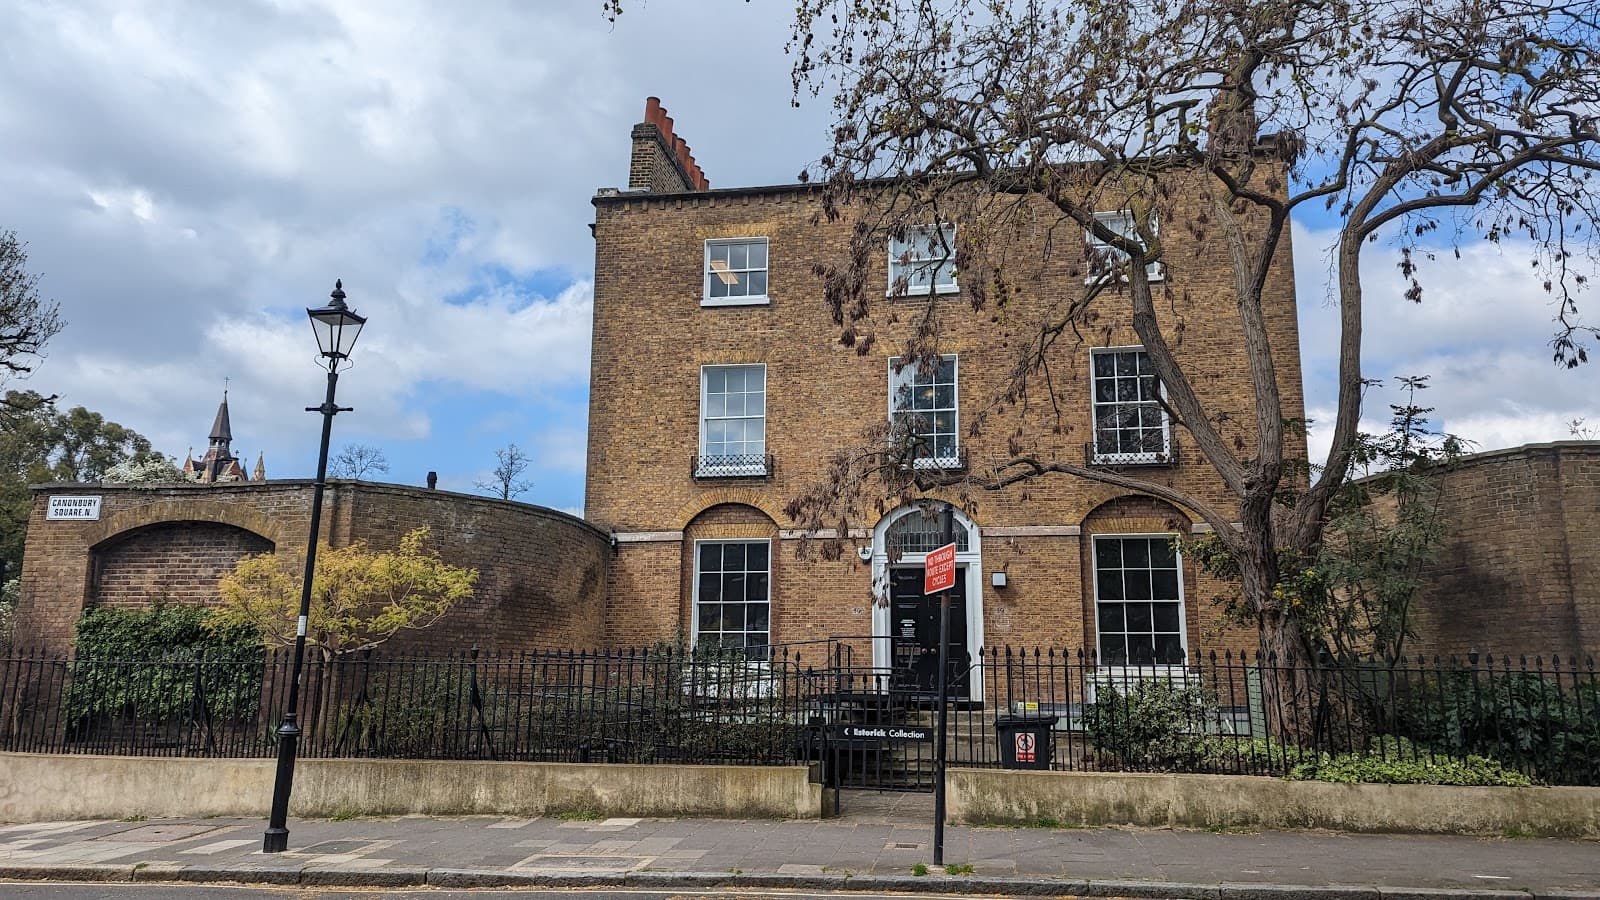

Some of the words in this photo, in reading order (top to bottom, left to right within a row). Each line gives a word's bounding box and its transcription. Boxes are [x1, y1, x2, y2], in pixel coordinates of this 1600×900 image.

[52, 499, 97, 507] CANONBURY
[927, 556, 934, 566] NO
[934, 549, 953, 564] THROUGH
[939, 560, 954, 573] EXCEPT
[932, 573, 947, 586] CYCLES
[853, 727, 886, 737] Estorick
[888, 729, 925, 739] Collection
